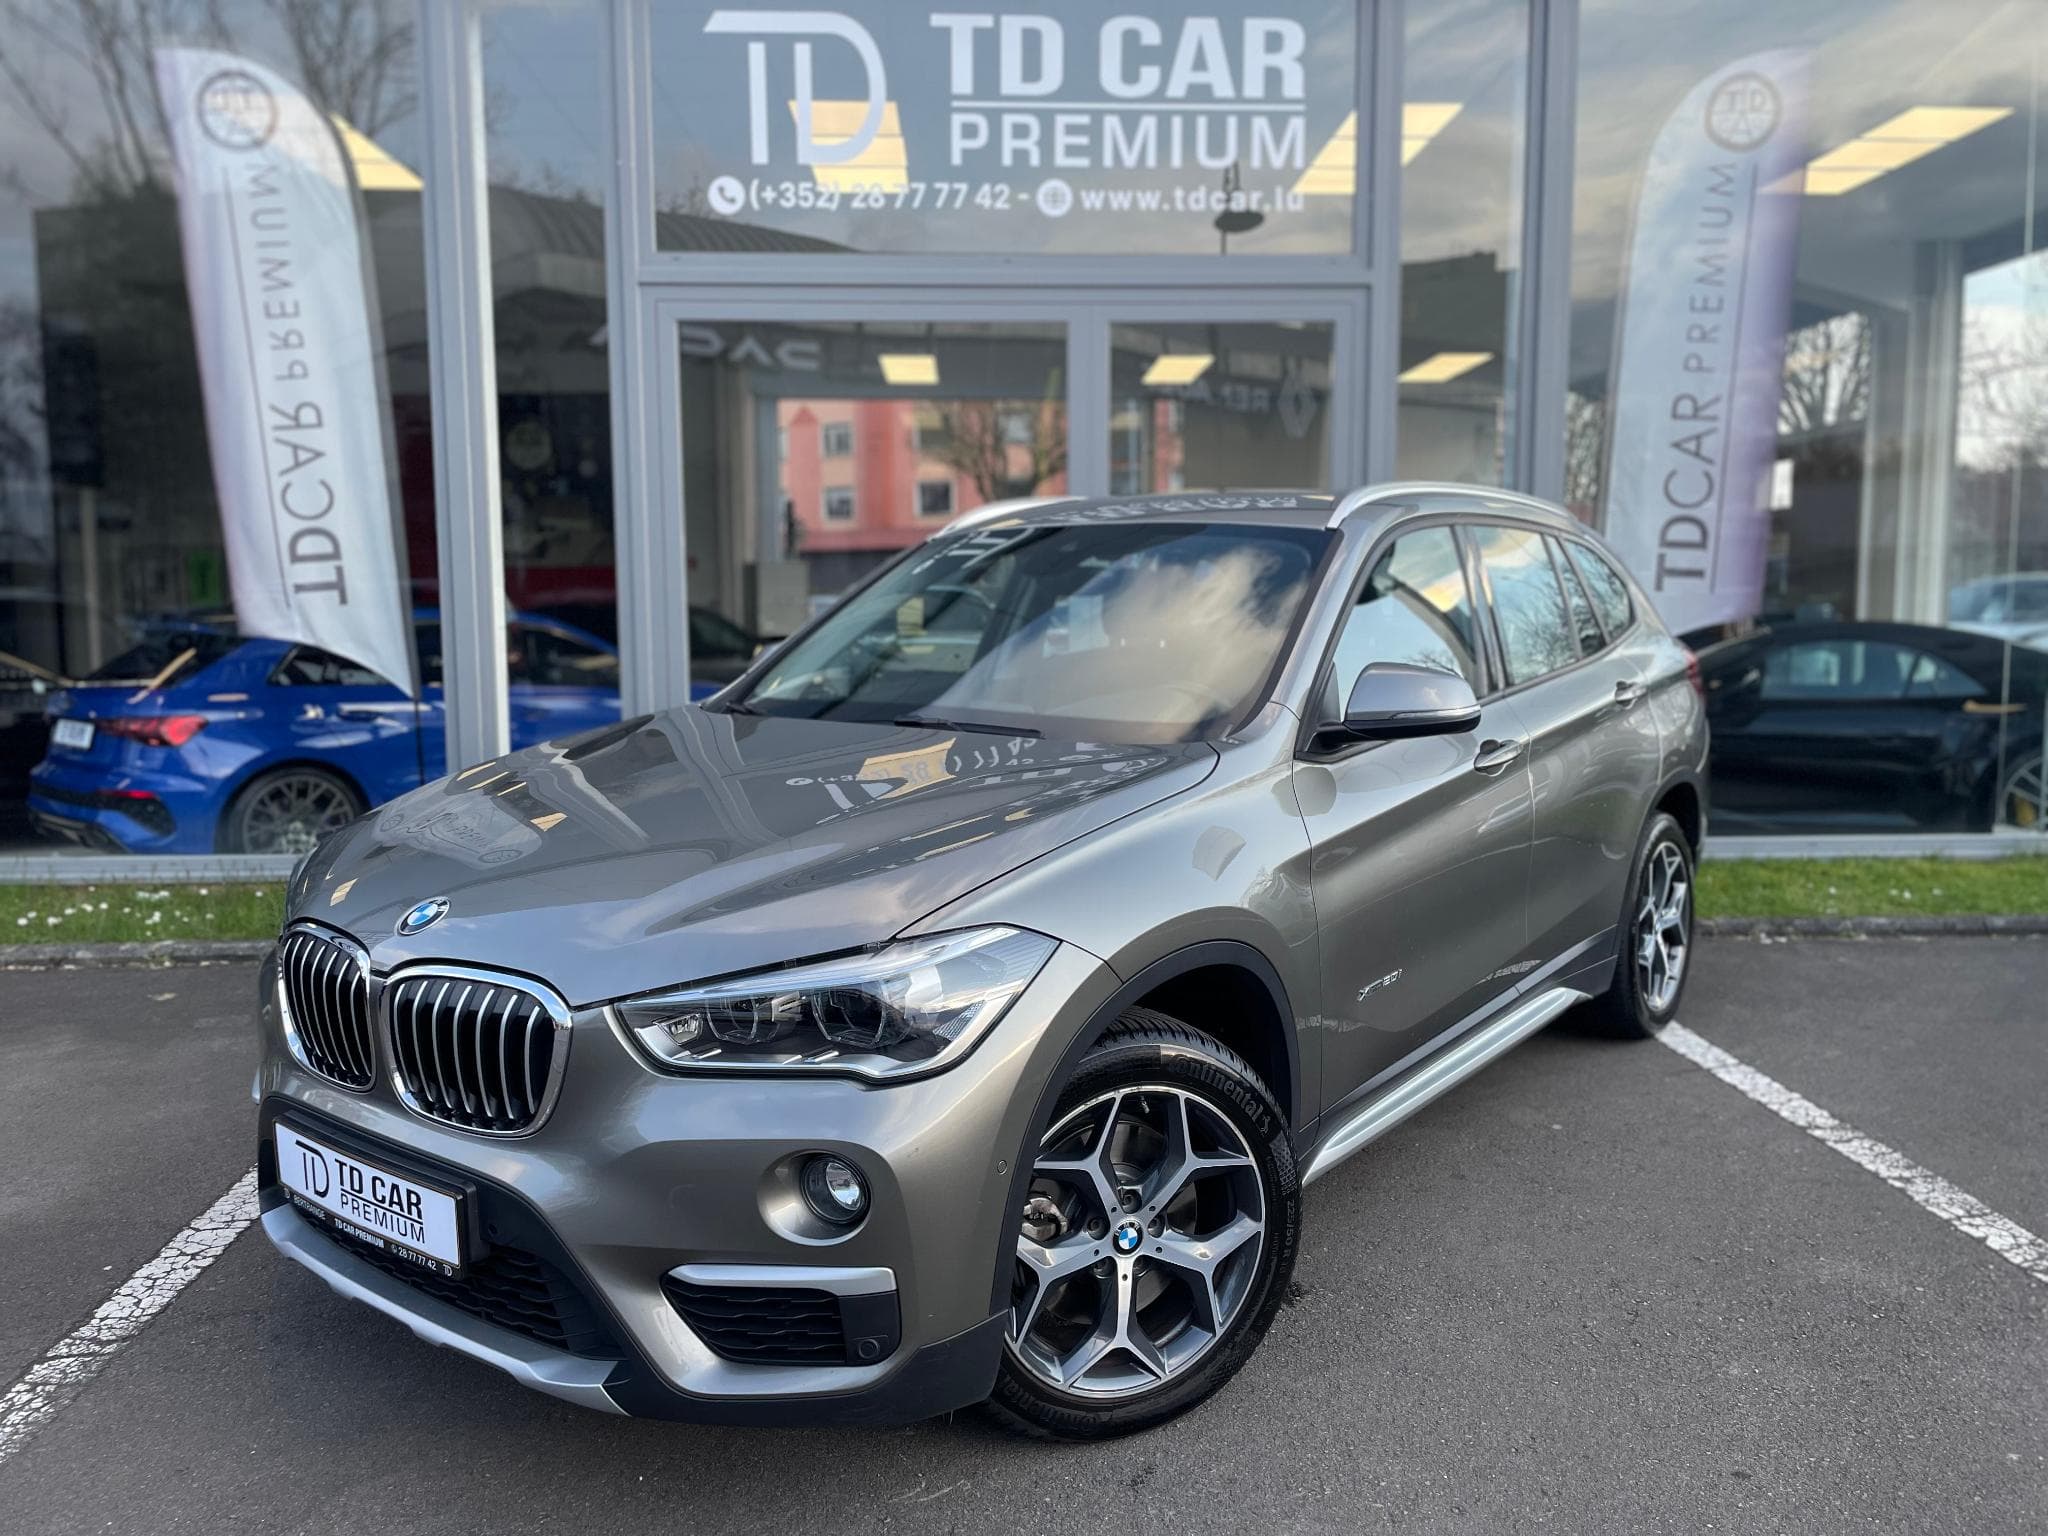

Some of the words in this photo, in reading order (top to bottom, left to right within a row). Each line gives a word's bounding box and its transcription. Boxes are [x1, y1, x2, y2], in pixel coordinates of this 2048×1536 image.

[930, 14, 1064, 96] TD
[1100, 16, 1306, 99] CAR
[950, 113, 1305, 170] PREMIUM
[850, 180, 886, 209] 28
[893, 180, 927, 209] 77
[934, 180, 969, 210] 77
[974, 180, 1012, 210] 42
[1682, 161, 1738, 374] PREMIUM
[1653, 392, 1723, 592] TDCAR
[334, 1158, 364, 1195] TD
[371, 1175, 423, 1220] CAR
[340, 1192, 425, 1244] PREMIUM
[355, 1228, 384, 1249] PREMIUM
[398, 1246, 407, 1259] 28
[408, 1250, 416, 1262] 77
[417, 1254, 426, 1266] 77
[427, 1259, 437, 1271] 42
